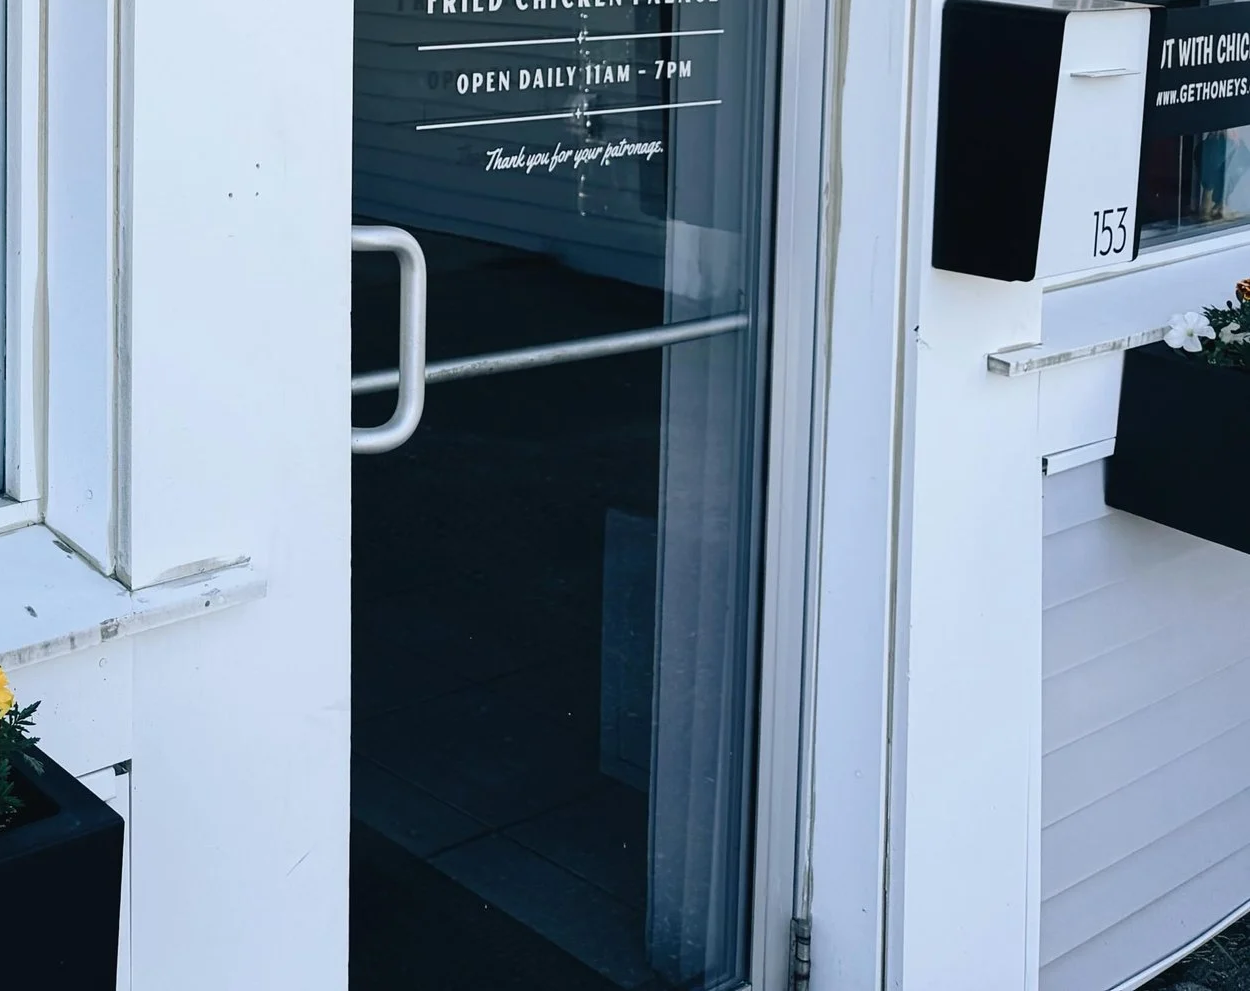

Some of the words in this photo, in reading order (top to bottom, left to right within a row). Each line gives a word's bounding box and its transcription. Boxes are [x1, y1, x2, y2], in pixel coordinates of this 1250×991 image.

[1179, 34, 1214, 67] WITH
[1216, 32, 1250, 64] CHIC
[456, 70, 511, 95] OPEN
[519, 66, 577, 90] DAILY
[585, 64, 631, 85] 11AM
[654, 60, 692, 80] 7PM
[485, 146, 526, 171] Thank
[526, 152, 550, 174] you
[548, 142, 573, 172] for
[573, 147, 603, 169] your
[600, 138, 664, 166] patronage.
[1093, 207, 1128, 257] 153
